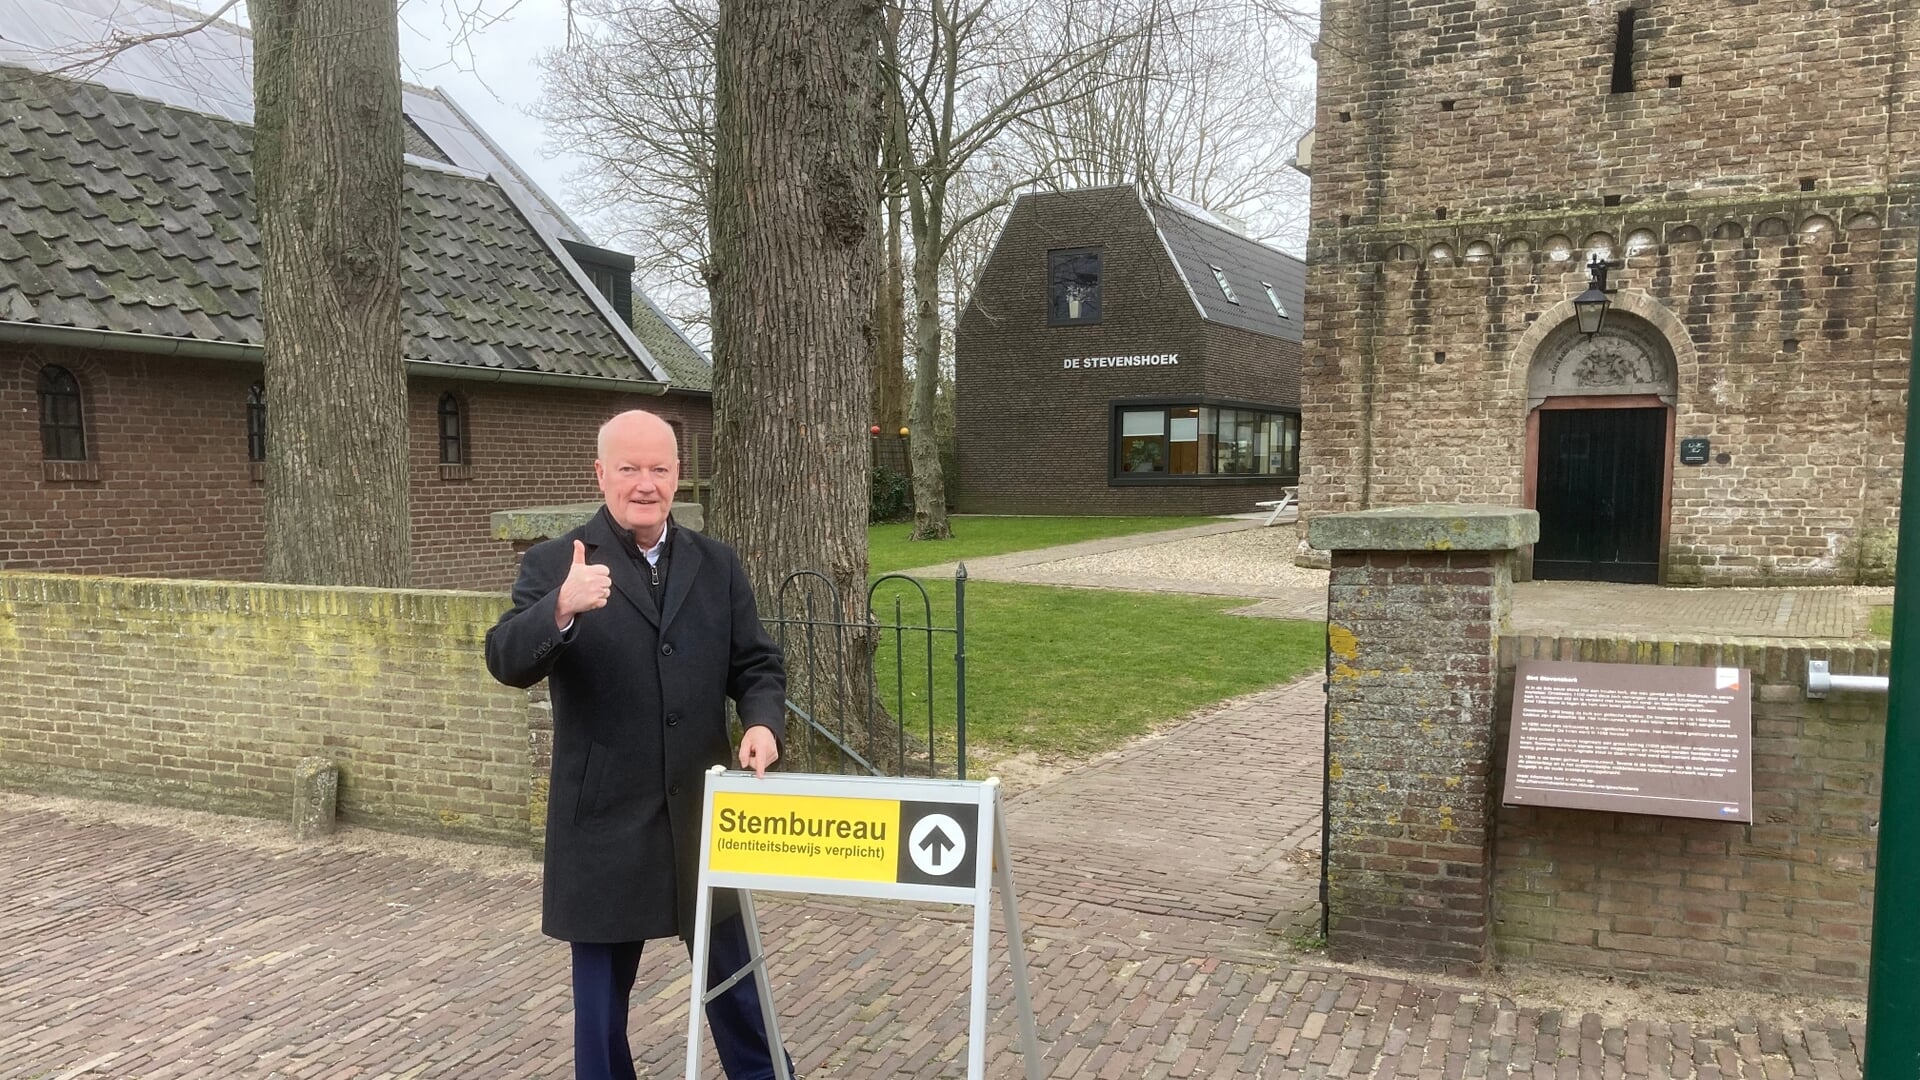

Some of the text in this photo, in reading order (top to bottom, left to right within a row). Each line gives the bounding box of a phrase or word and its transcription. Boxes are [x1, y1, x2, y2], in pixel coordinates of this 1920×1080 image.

[1063, 353, 1179, 369] DE STEVENSHOEK
[718, 807, 887, 841] Stembureau
[717, 838, 886, 861] (Identiteitsbewijs verplicht)
